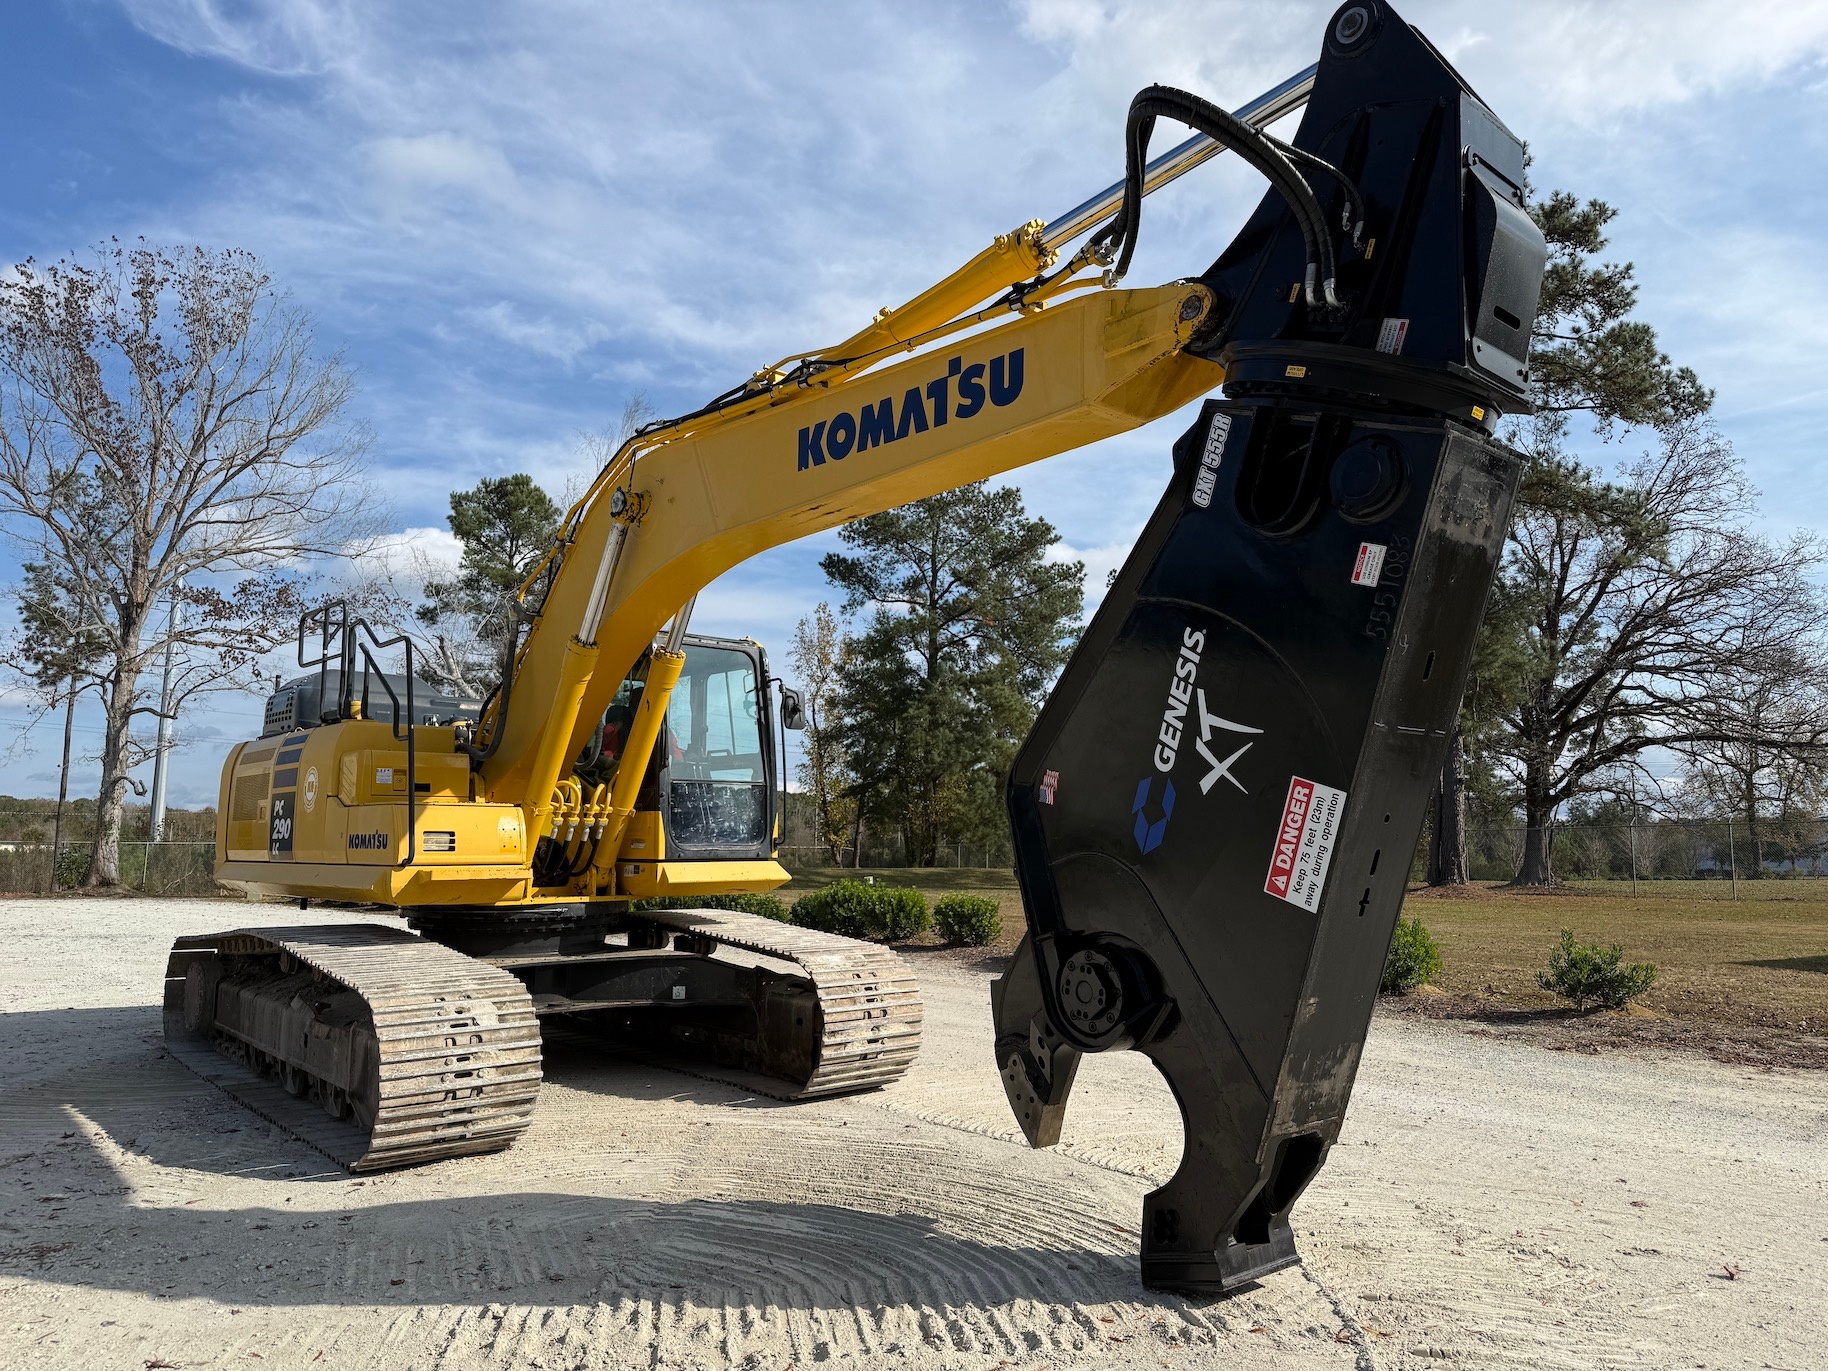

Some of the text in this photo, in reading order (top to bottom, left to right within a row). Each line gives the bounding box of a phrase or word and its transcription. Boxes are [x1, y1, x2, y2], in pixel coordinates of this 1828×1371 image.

[797, 347, 1024, 472] KOMATSU
[1192, 412, 1232, 508] GXT 555R
[1154, 626, 1205, 773] GENESIS
[1195, 688, 1264, 796] XT
[272, 818, 291, 840] 290
[272, 842, 280, 855] LC
[273, 800, 285, 816] PC
[348, 829, 388, 849] KOMATSU
[1275, 785, 1310, 871] DANGER
[1292, 796, 1327, 894] Keep 75 feet (23m)
[1304, 793, 1340, 907] away during operation
